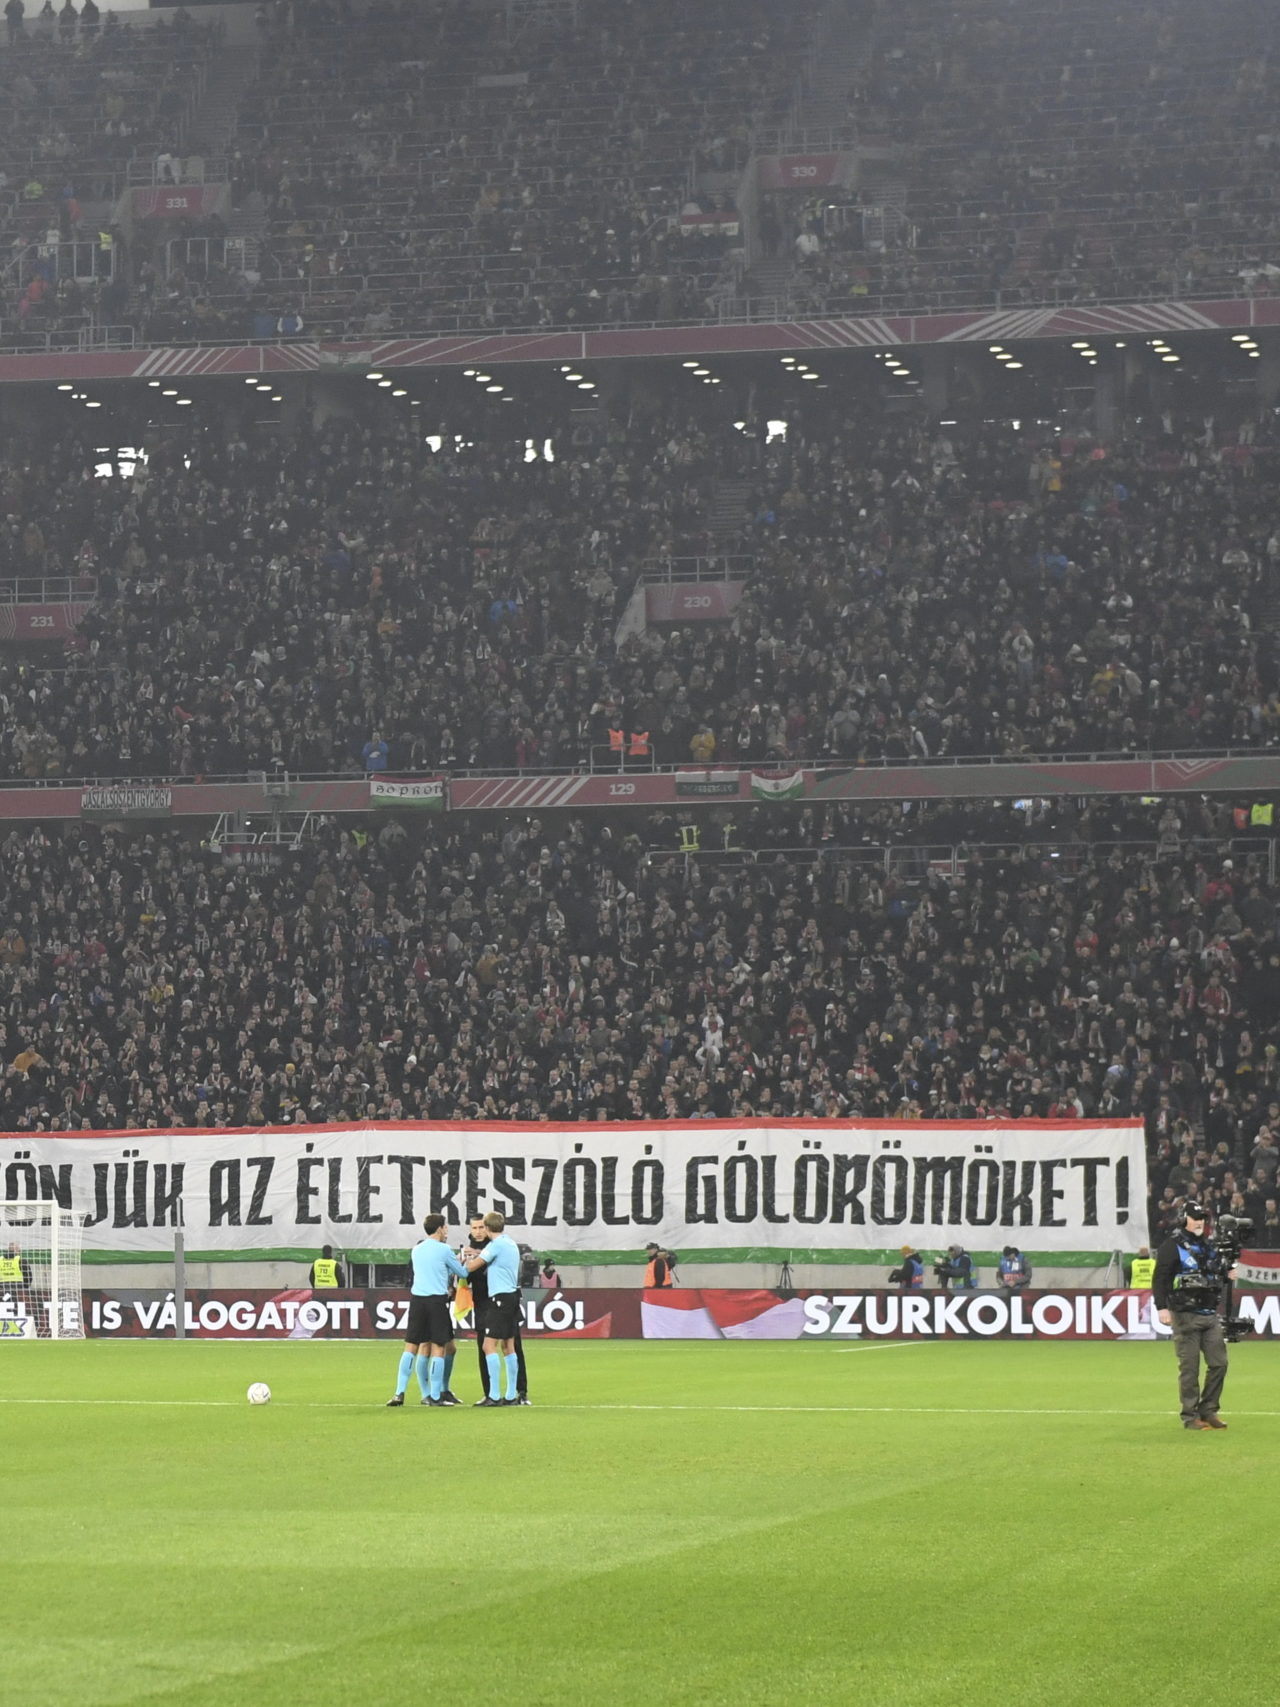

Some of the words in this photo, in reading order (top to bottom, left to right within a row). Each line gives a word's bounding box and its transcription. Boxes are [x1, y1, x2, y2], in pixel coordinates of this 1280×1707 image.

[791, 166, 817, 178] 330
[166, 198, 188, 209] 331
[683, 596, 712, 608] 230
[30, 616, 55, 627] 231
[609, 783, 636, 795] 129
[209, 1156, 274, 1227] AZ
[295, 1143, 665, 1227] ÉLETRESZÓLÓ
[685, 1140, 1130, 1227] GÓLÖRÖMÖKET!
[92, 1301, 121, 1330] IS
[133, 1293, 363, 1331] VÁLOGATOTT
